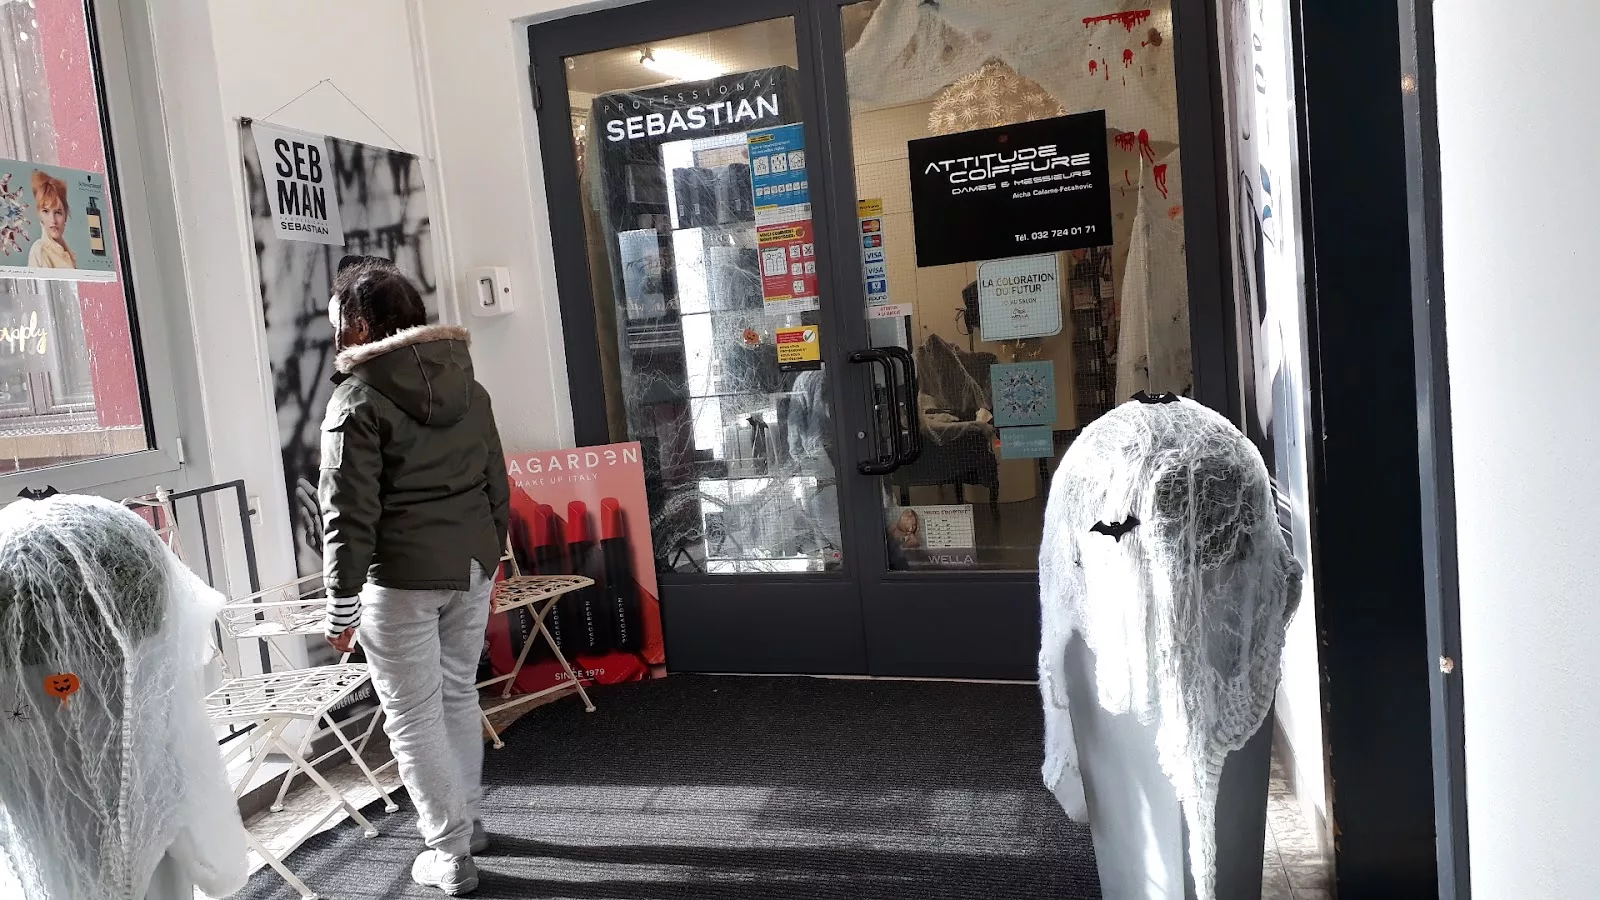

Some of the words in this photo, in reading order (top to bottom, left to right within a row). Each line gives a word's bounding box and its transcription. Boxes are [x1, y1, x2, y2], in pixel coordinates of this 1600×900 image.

[604, 77, 776, 113] PROFESSIONAL
[606, 93, 779, 142] SEBASTIAN
[274, 138, 323, 184] SEB
[925, 144, 1057, 175] ATTITUDE
[949, 153, 1091, 184] COIFFURE
[951, 183, 997, 195] DAMES
[1013, 170, 1092, 186] MESSIEURS
[277, 179, 328, 221] MAN
[280, 221, 329, 235] SEBASTIAN
[1015, 233, 1029, 242] Tél.
[1031, 231, 1049, 240] 032
[1051, 229, 1069, 238] 724
[1071, 227, 1082, 236] 01
[1085, 225, 1096, 234] 71
[867, 251, 883, 260] VISA
[982, 279, 994, 288] LA
[996, 272, 1055, 287] COLORATION
[996, 288, 1009, 297] DU
[1011, 284, 1042, 295] FUTUR
[508, 447, 638, 475] AGARDEN
[515, 478, 544, 488] MAKE
[568, 473, 598, 482] ITALY
[928, 555, 974, 564] WELLA
[519, 608, 529, 645] GARDEN
[554, 670, 583, 681] SINCE
[585, 668, 605, 677] 1979
[328, 687, 371, 713] UNDEFINABLE
